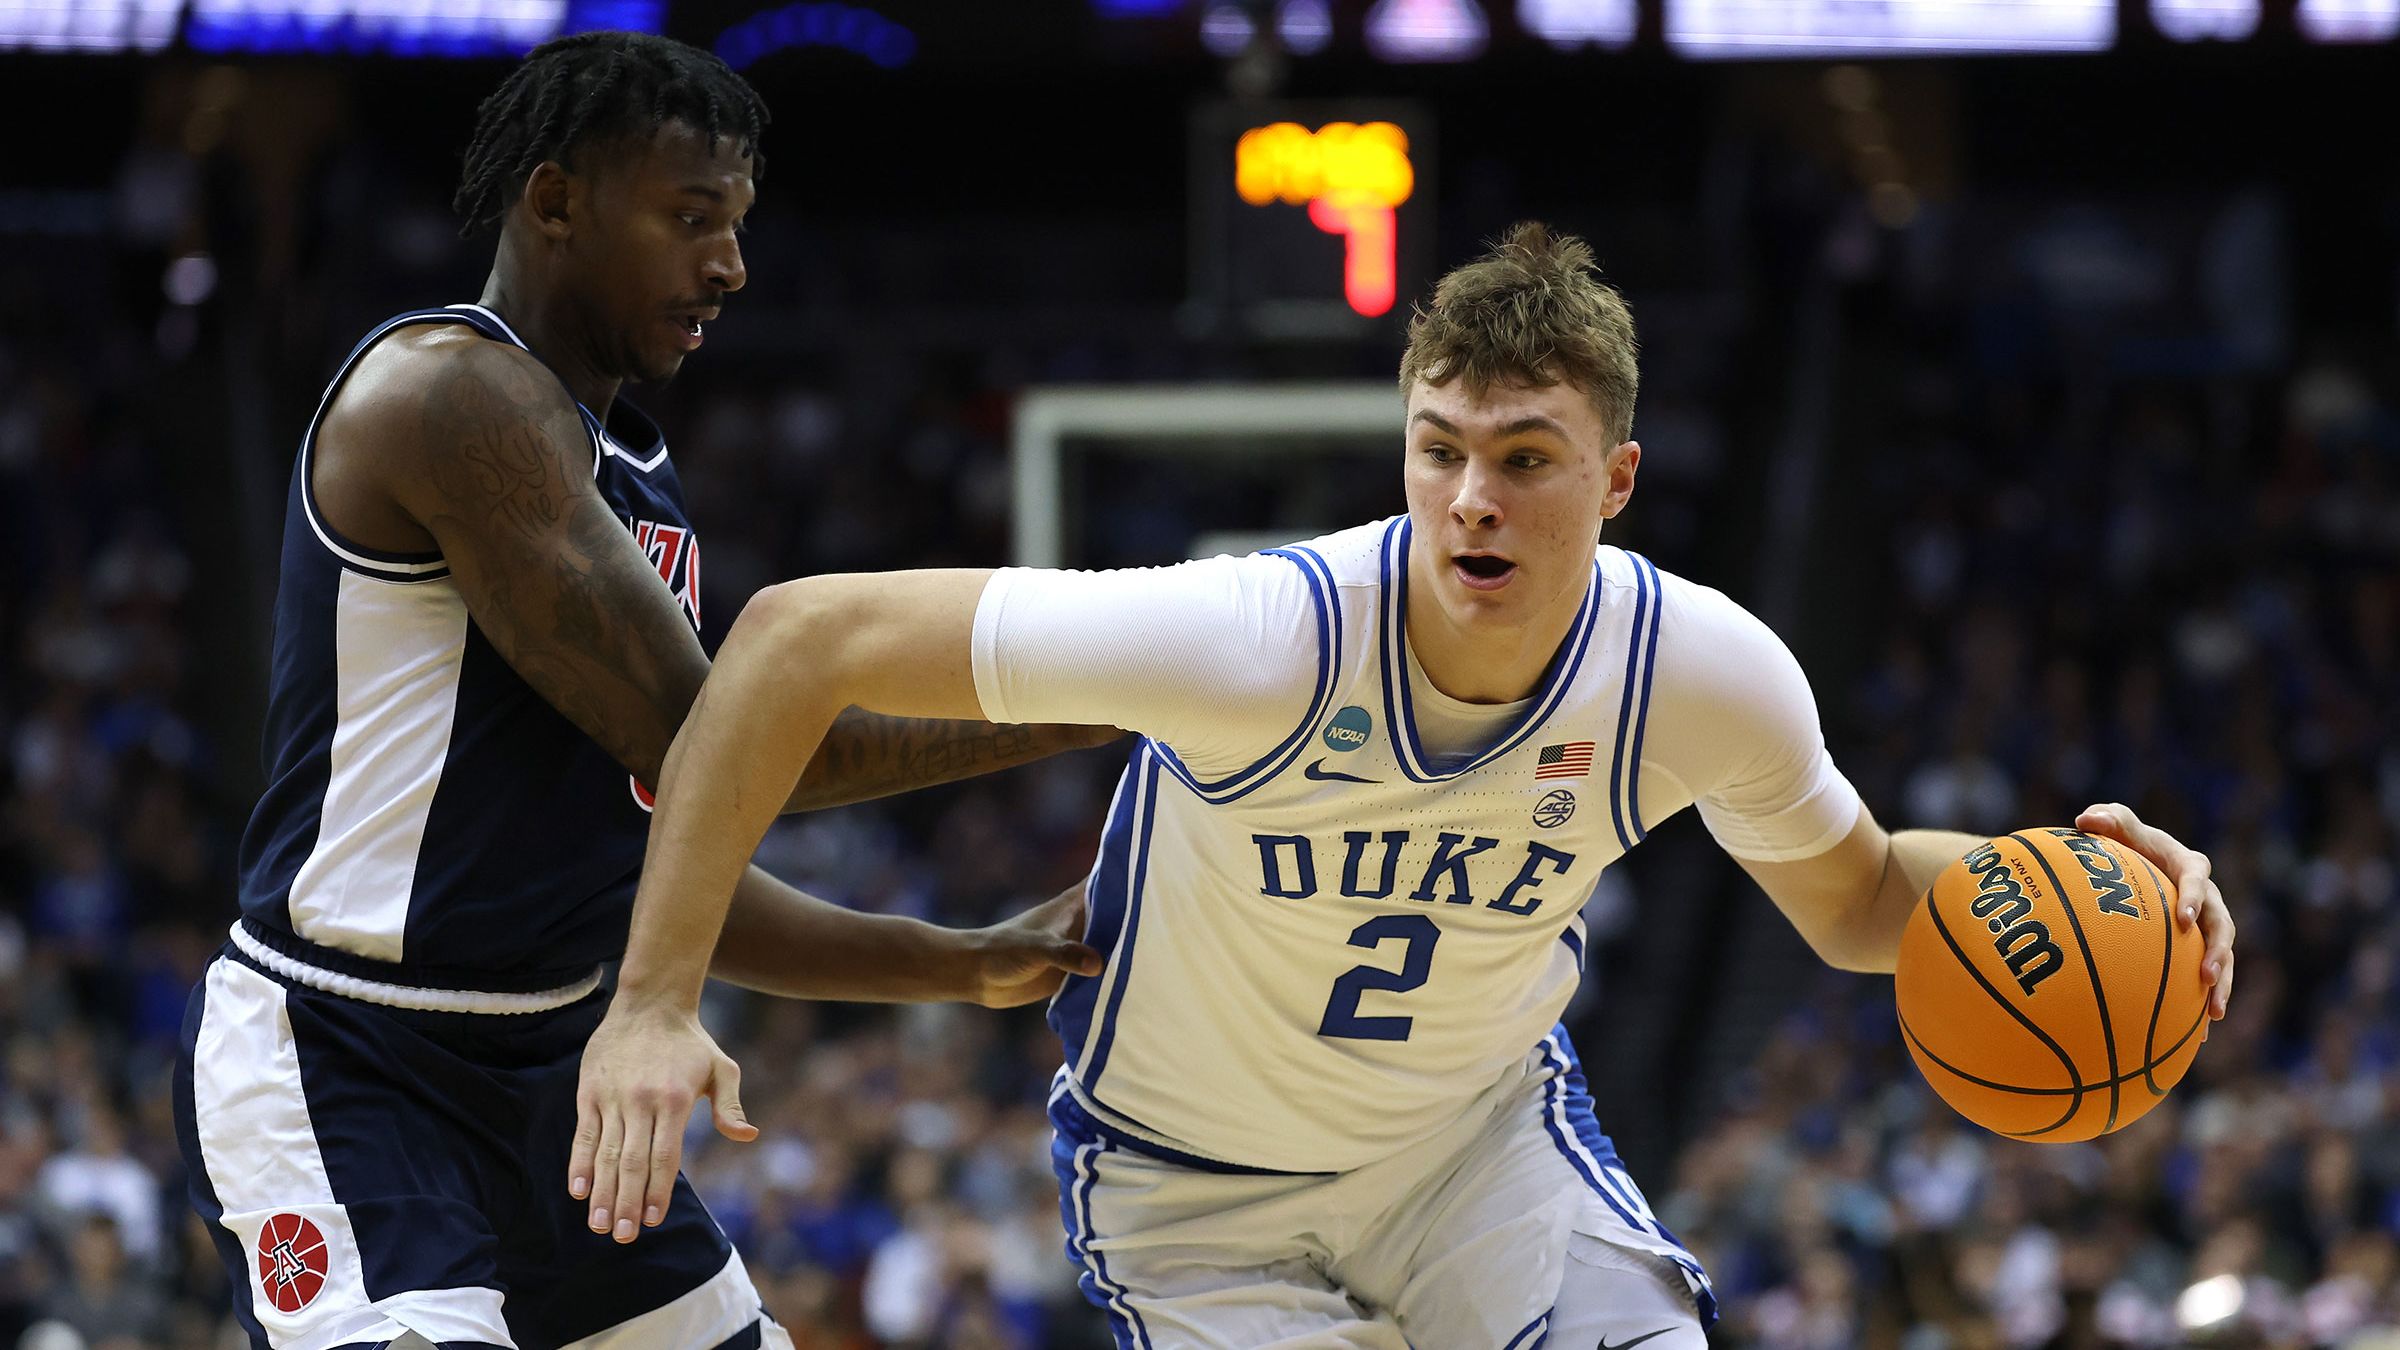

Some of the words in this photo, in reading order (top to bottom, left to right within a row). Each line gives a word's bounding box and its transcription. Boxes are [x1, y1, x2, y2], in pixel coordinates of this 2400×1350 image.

[1327, 726, 1366, 744] NCAA
[1535, 802, 1574, 814] ACC
[1251, 831, 1576, 916] DUKE
[2010, 857, 2027, 875] NXT
[2023, 875, 2043, 899] EVO
[1962, 842, 2065, 998] Wilson
[1317, 915, 1441, 1042] 2
[271, 1239, 307, 1288] A
